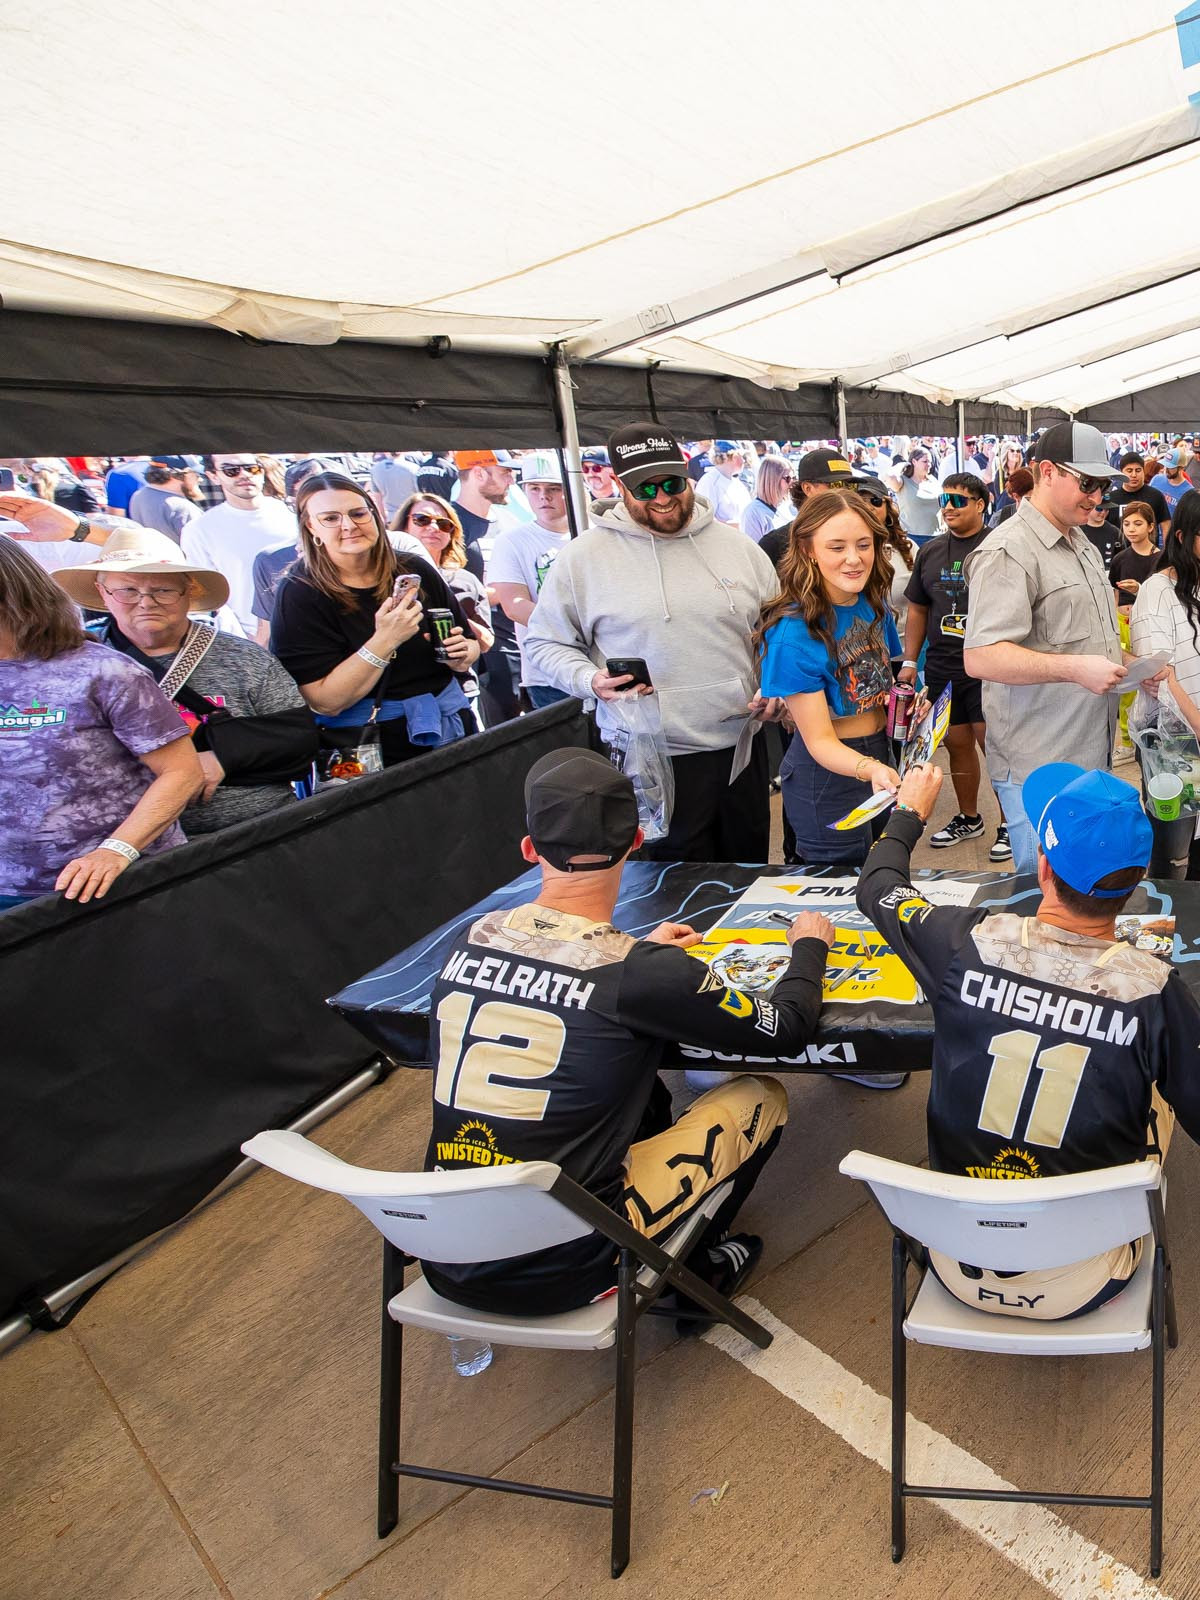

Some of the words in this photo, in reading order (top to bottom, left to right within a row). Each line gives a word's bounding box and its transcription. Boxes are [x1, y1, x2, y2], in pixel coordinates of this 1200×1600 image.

[616, 442, 648, 456] Wrong
[960, 969, 1139, 1046] CHISHOLM
[434, 990, 567, 1122] 12
[977, 1029, 1092, 1150] 11
[437, 1142, 493, 1166] TWISTED
[453, 1136, 471, 1144] HARD
[471, 1139, 487, 1148] ICED
[487, 1144, 499, 1152] TEA
[991, 1161, 1010, 1169] HARD
[1012, 1165, 1029, 1173] ICED
[979, 1286, 1045, 1309] FLY
